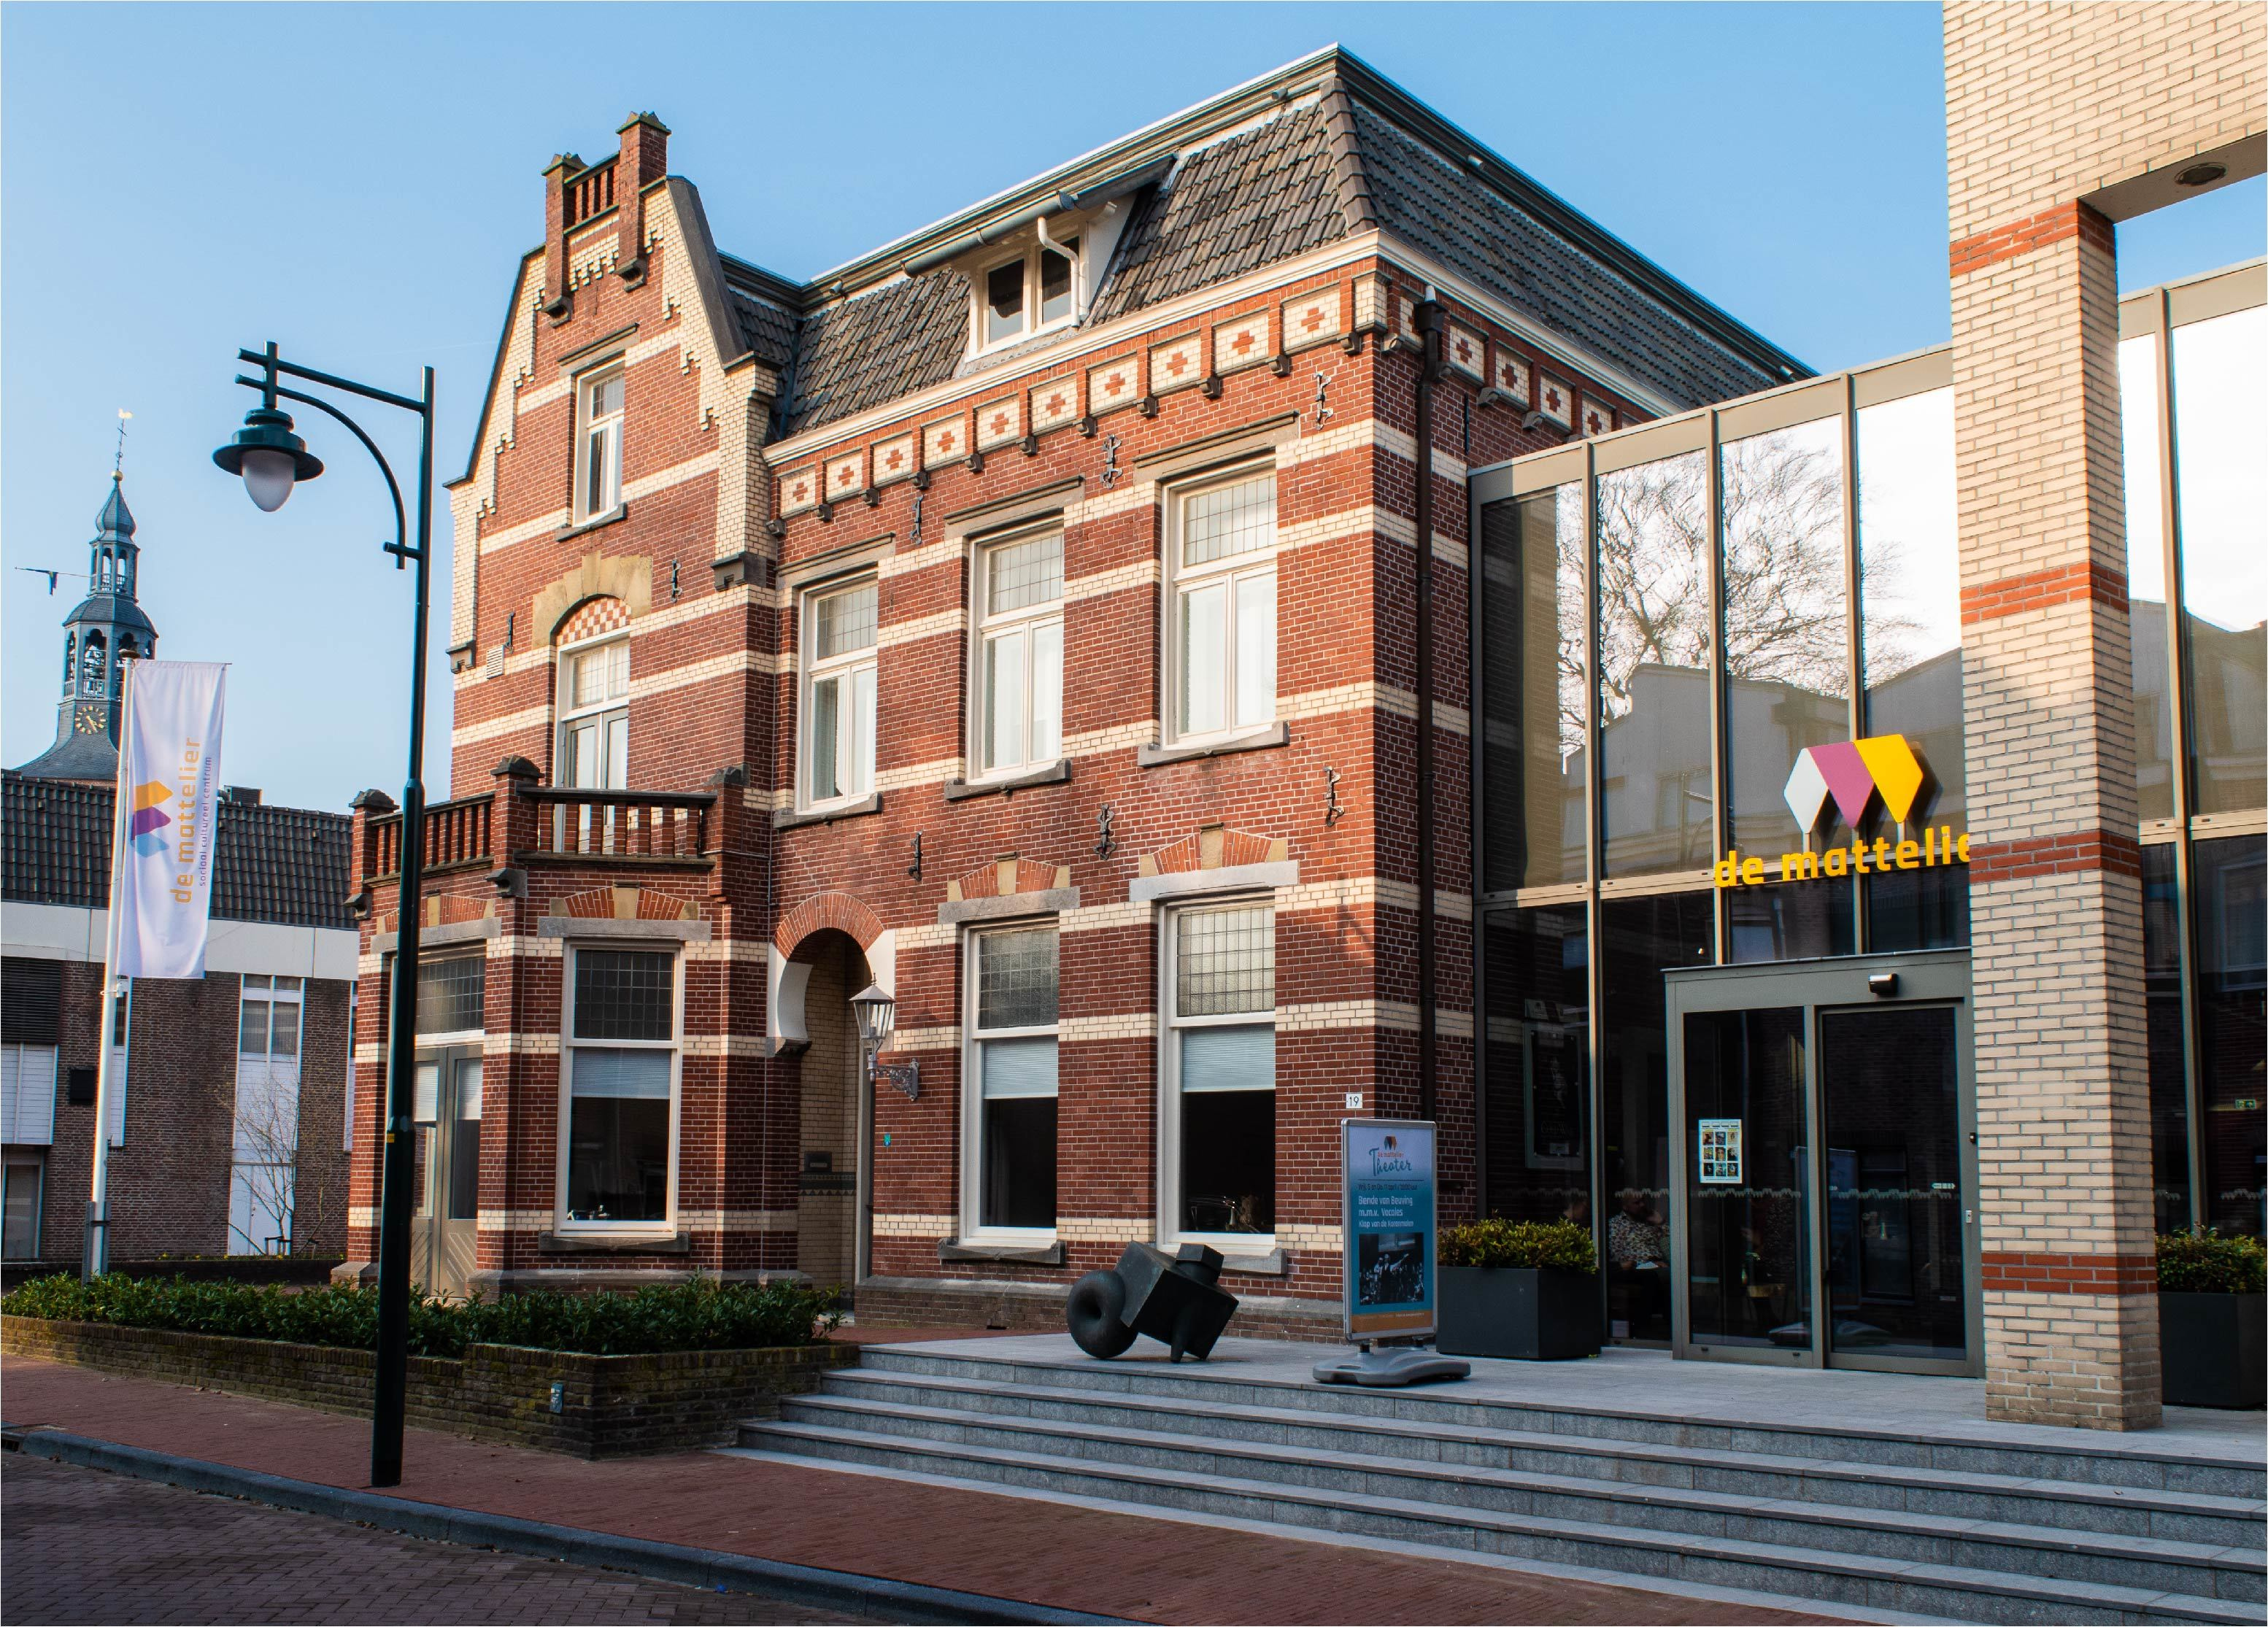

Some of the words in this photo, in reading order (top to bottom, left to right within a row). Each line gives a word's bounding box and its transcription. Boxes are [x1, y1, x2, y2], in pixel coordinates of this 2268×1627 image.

[202, 757, 212, 799] centrum
[177, 737, 201, 863] mattelier
[200, 803, 209, 848] cultureel
[199, 851, 207, 886] sociaal
[1715, 851, 1764, 887] de
[1782, 825, 1970, 881] mattelie
[169, 874, 194, 903] de
[1349, 1096, 1359, 1107] 19
[1369, 1147, 1412, 1177] Theater
[1358, 1195, 1378, 1205] Bende
[1379, 1197, 1390, 1205] van
[1358, 1209, 1379, 1217] m.m.v.
